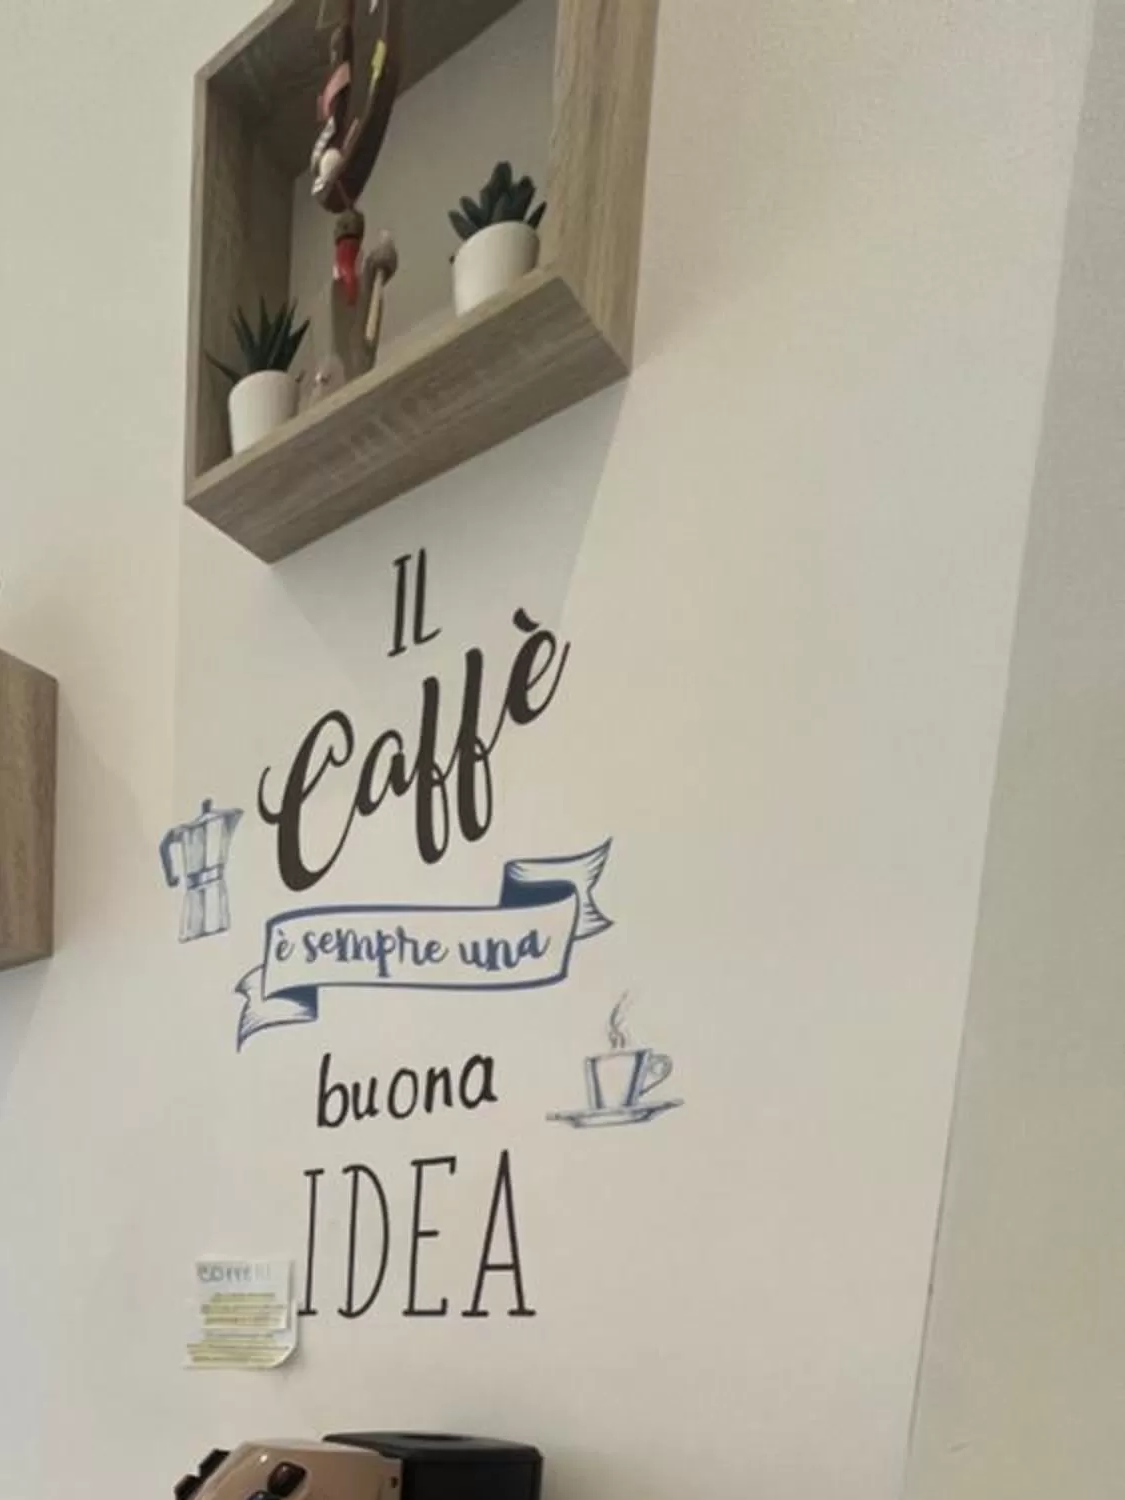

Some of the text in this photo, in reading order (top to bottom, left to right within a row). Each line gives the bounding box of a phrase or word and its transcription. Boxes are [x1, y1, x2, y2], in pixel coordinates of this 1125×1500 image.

[257, 606, 572, 893] Caffè
[274, 924, 551, 979] è sempre una
[316, 1051, 499, 1129] buona
[296, 1148, 537, 1319] IDEA
